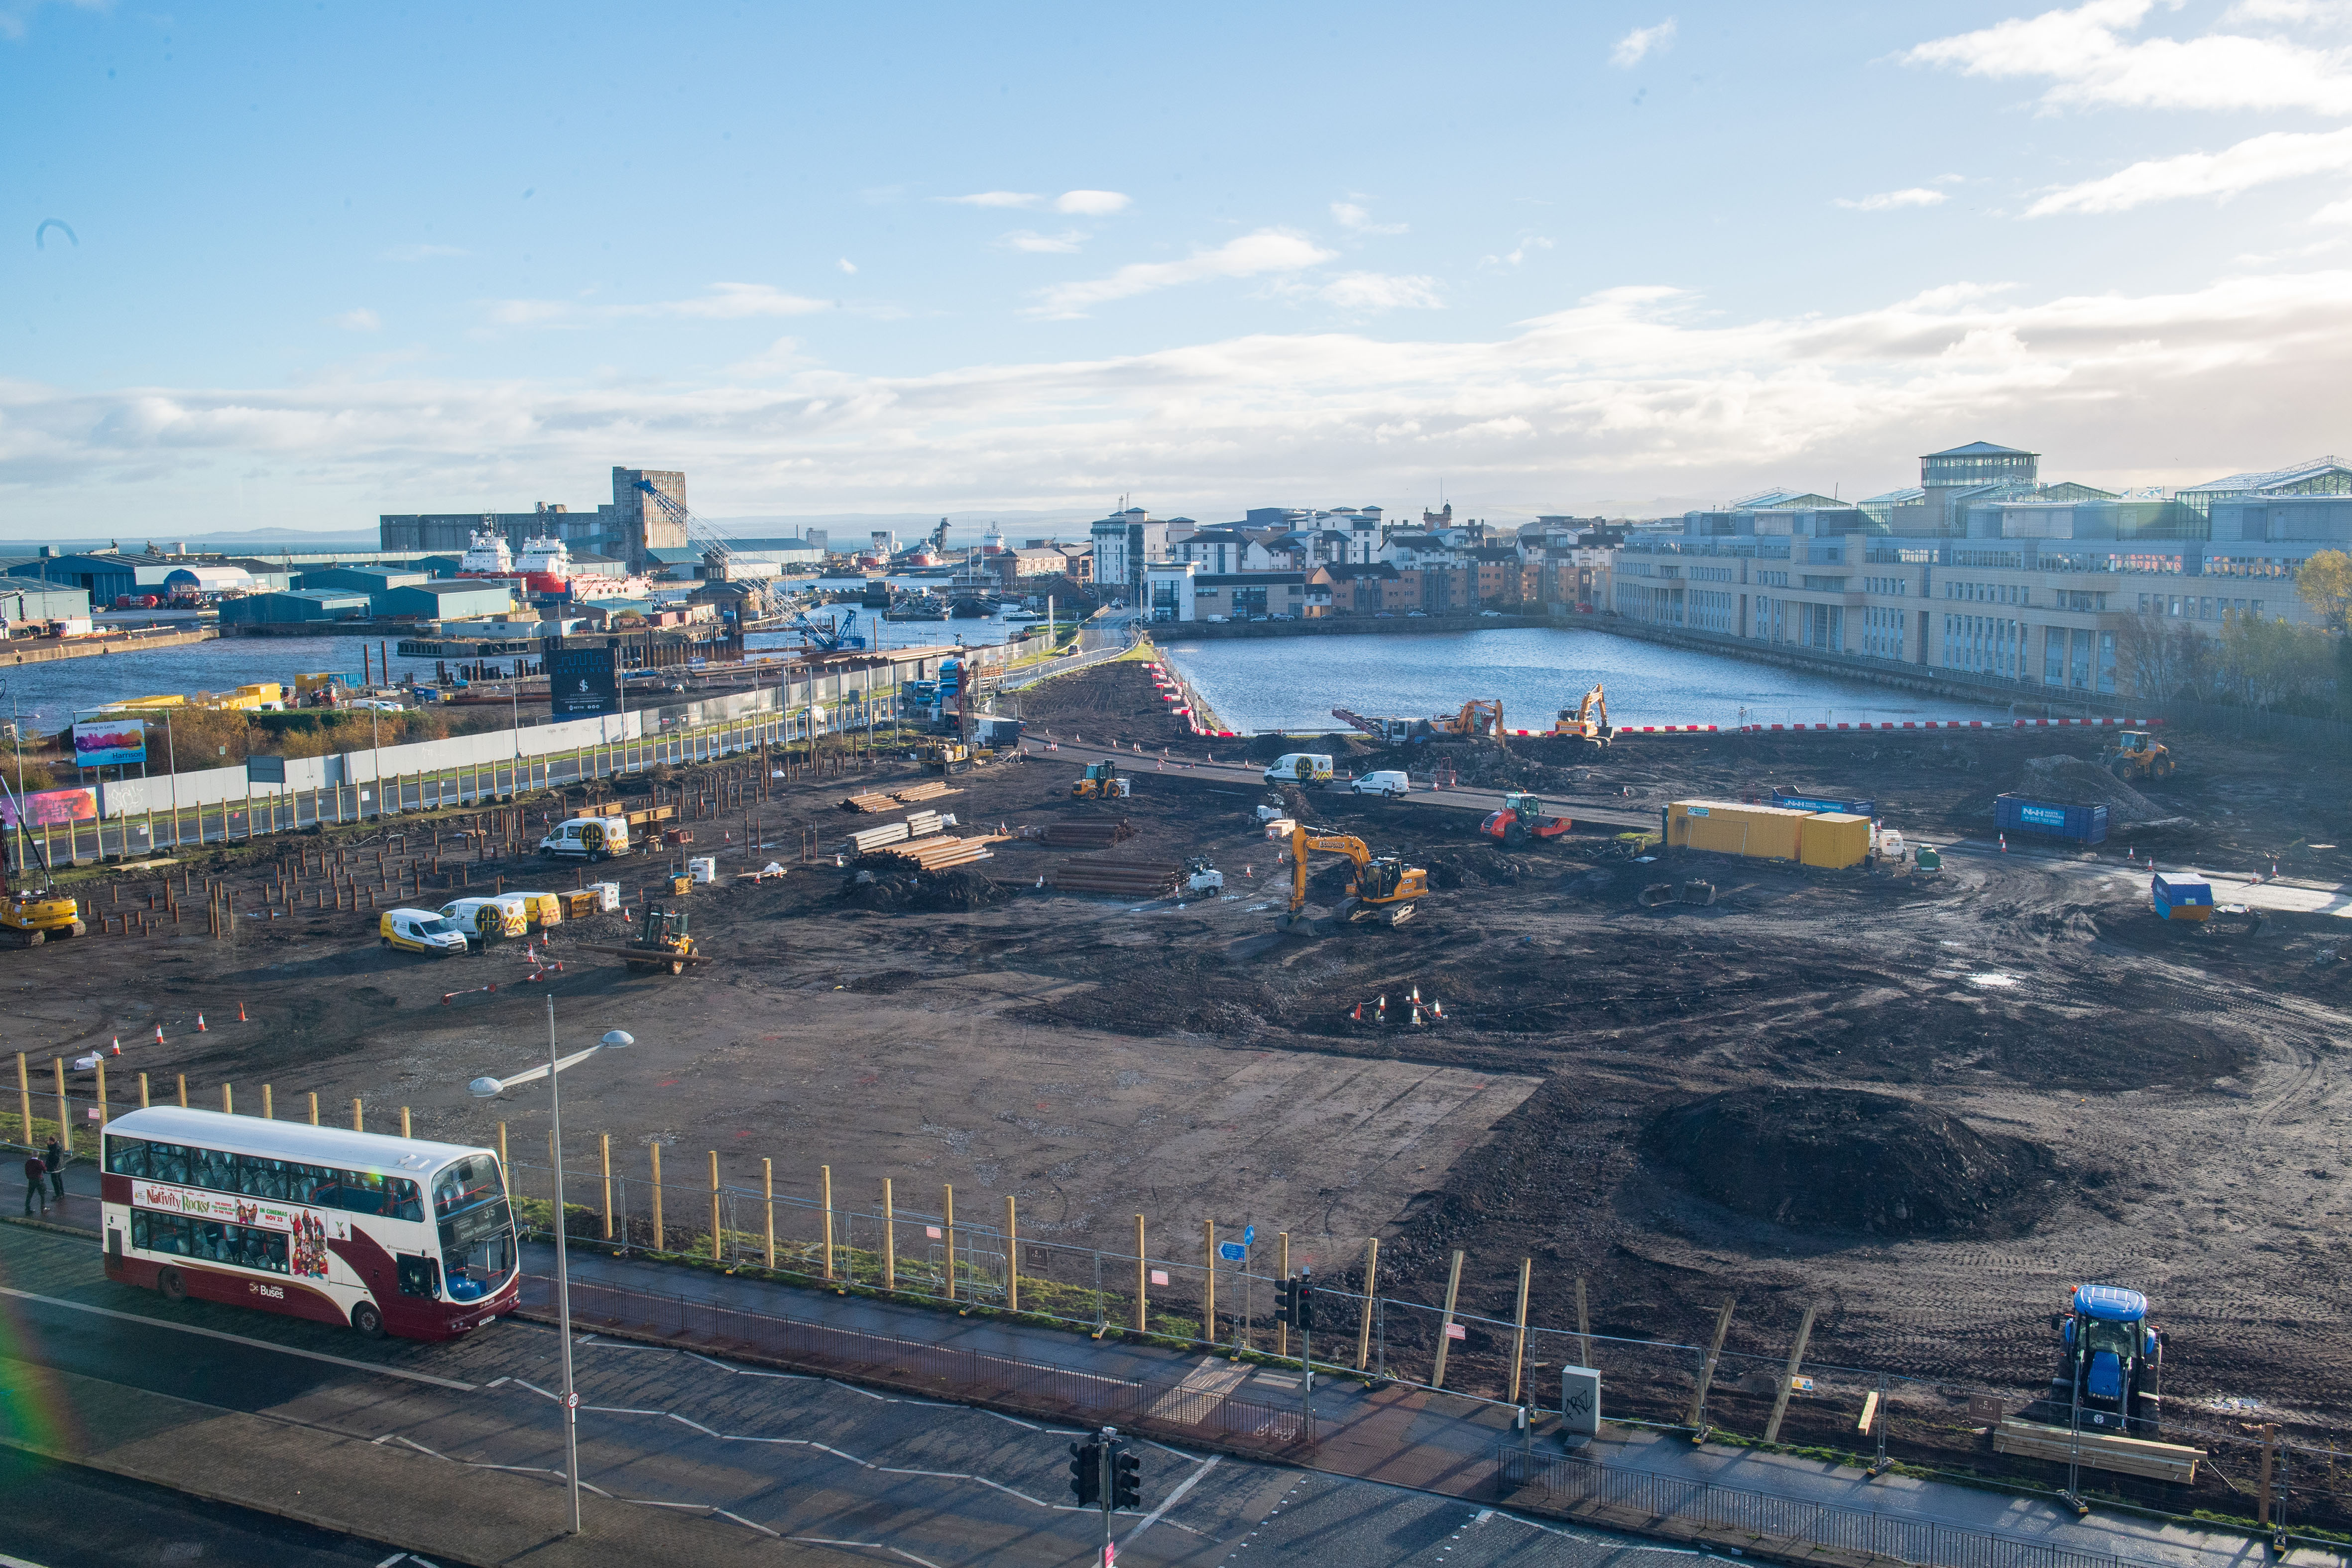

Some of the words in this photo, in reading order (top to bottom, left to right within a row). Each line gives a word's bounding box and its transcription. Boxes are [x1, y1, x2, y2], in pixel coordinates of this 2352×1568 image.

[2023, 807, 2043, 816] NWH
[146, 1189, 181, 1211] Nativity
[266, 1209, 288, 1217] CINEMAS
[484, 1208, 496, 1219] 35
[461, 1230, 474, 1239] Ocean
[474, 1222, 492, 1234] Terminal
[260, 1285, 284, 1299] Buses
[570, 1396, 578, 1405] 20
